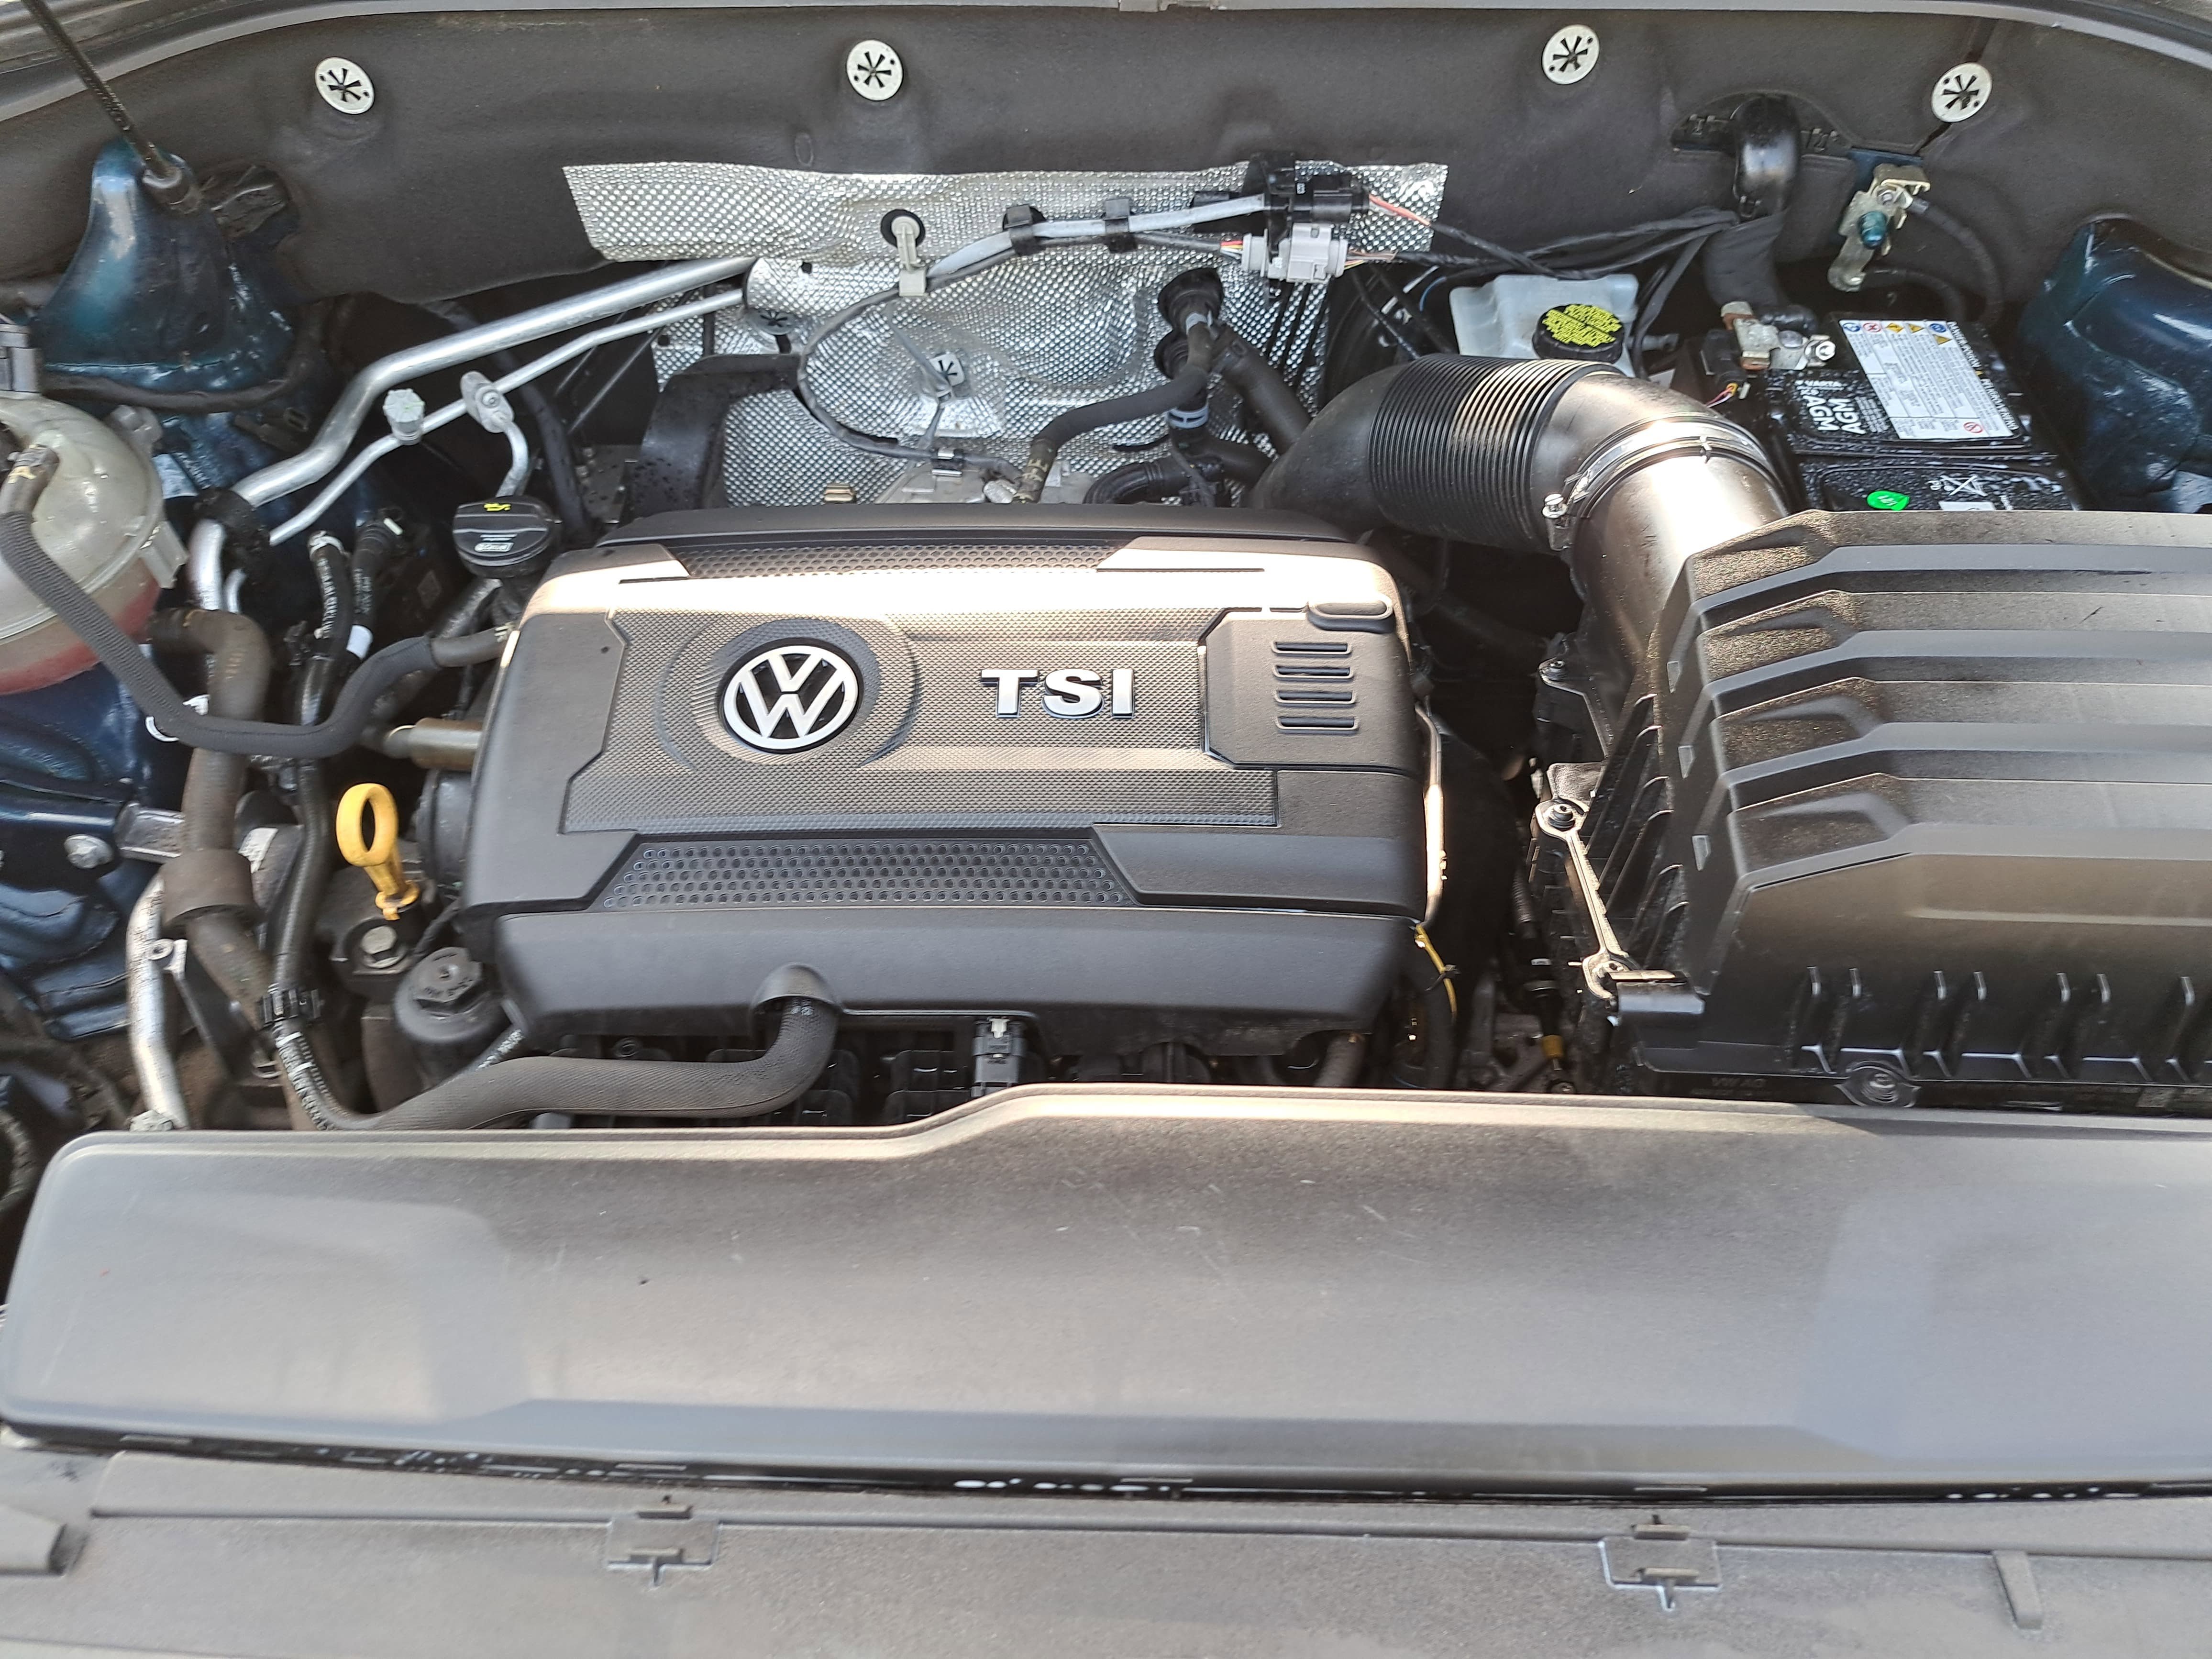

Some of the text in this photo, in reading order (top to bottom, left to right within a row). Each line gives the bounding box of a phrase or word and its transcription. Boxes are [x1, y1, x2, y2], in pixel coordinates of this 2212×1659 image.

[1803, 395, 1840, 431] AGM
[1828, 398, 1866, 434] AGM
[980, 668, 1135, 719] TSI
